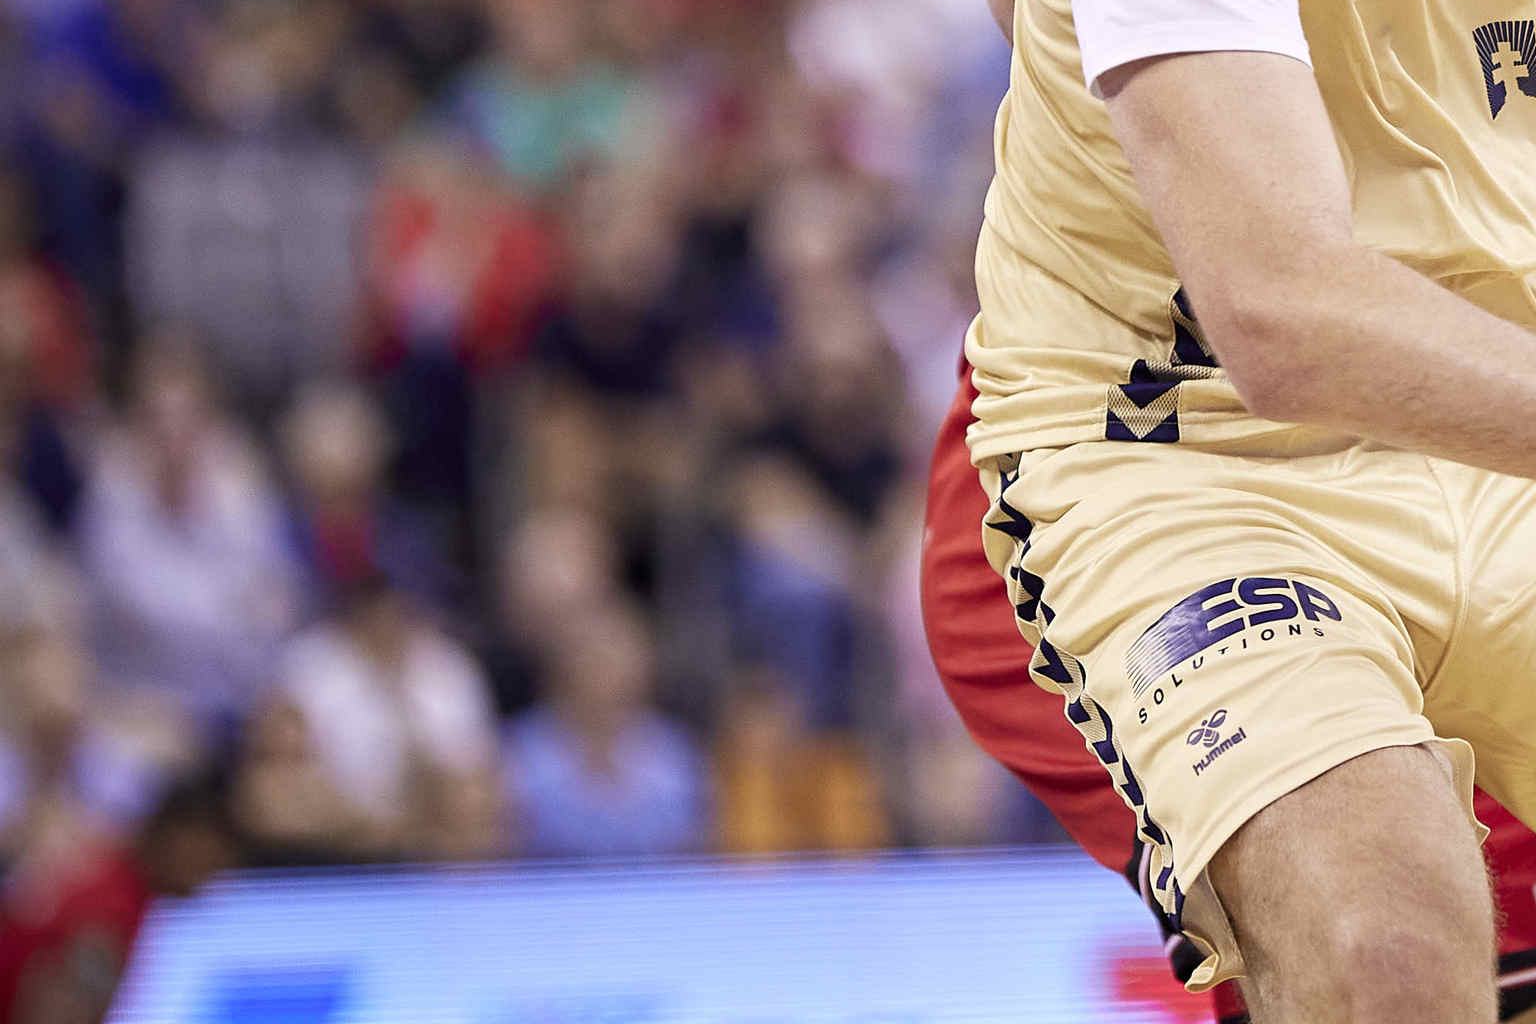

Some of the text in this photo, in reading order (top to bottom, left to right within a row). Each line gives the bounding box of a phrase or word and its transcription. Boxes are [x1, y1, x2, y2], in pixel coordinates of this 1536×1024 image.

[1160, 576, 1343, 673] ESP
[1138, 624, 1325, 724] SOLUTIONS
[1191, 727, 1247, 776] hummel
